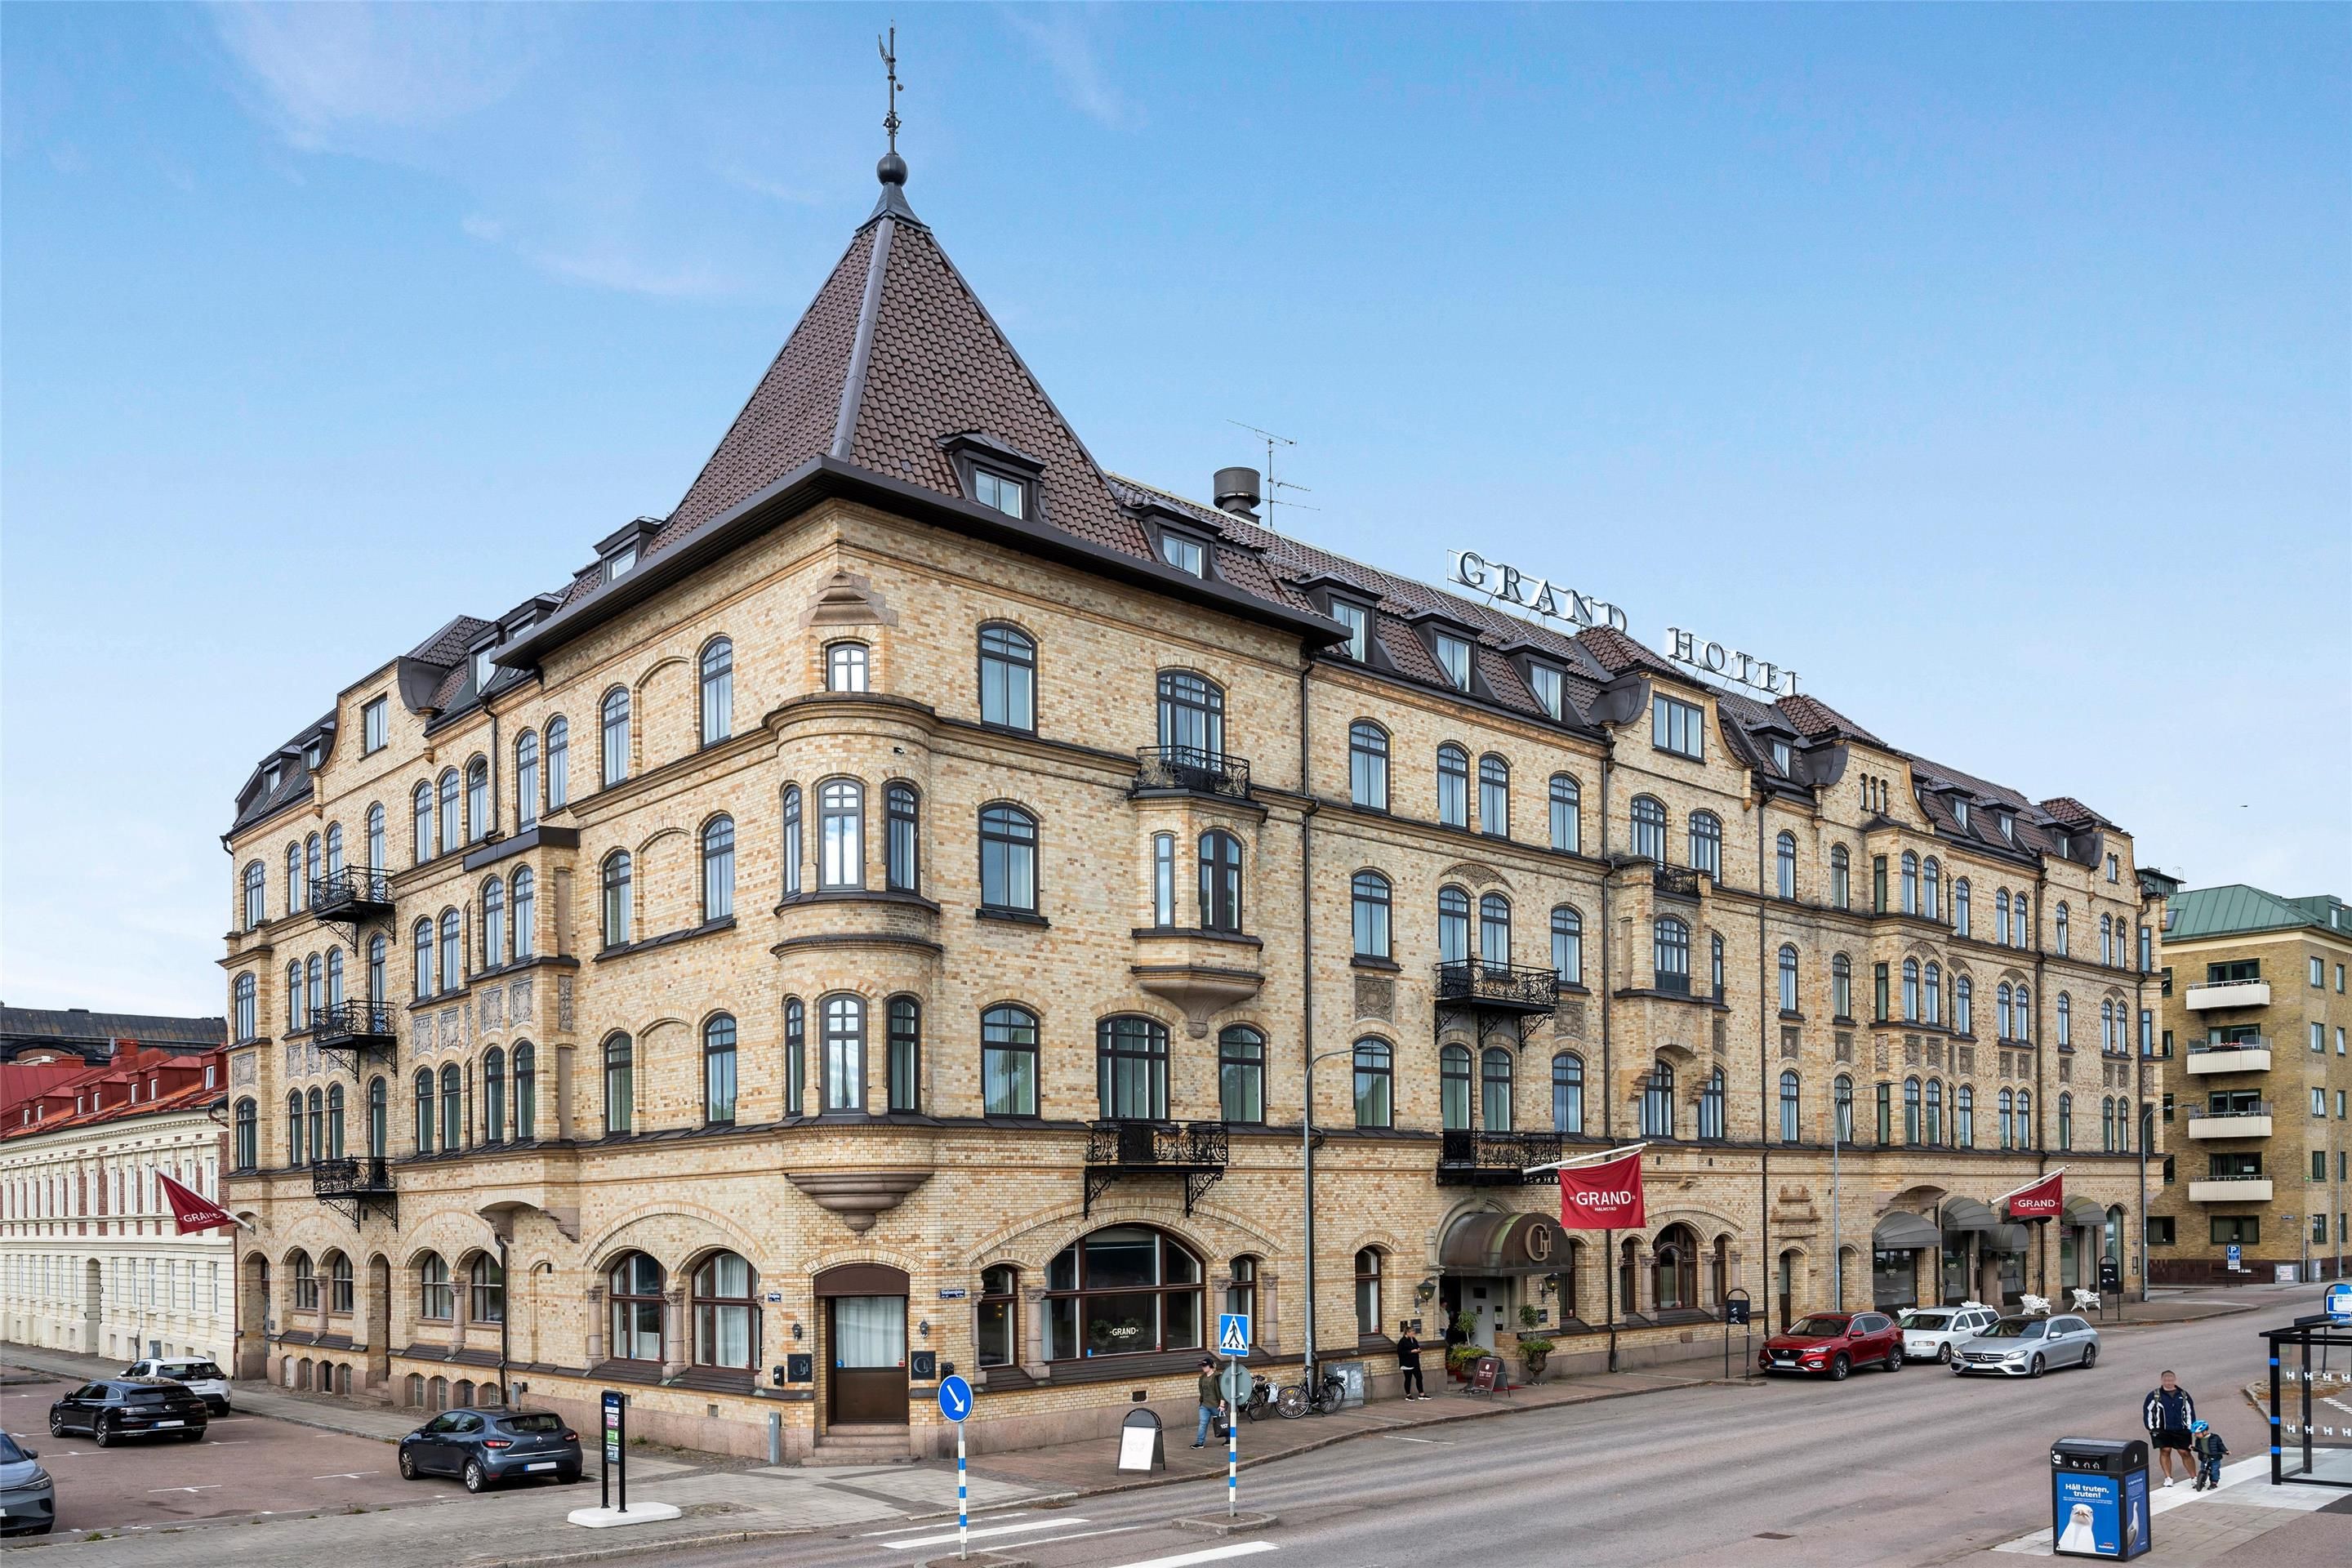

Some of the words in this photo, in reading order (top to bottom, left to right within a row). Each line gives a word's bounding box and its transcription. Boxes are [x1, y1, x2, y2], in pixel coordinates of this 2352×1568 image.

[1457, 551, 1628, 634] GRAND
[1576, 1191, 1632, 1205] GRAND
[2018, 1199, 2056, 1207] GRAND
[183, 1212, 221, 1223] GRA
[1111, 1327, 1136, 1336] GRAND
[2082, 1485, 2109, 1494] truten,
[2074, 1490, 2101, 1499] truten!
